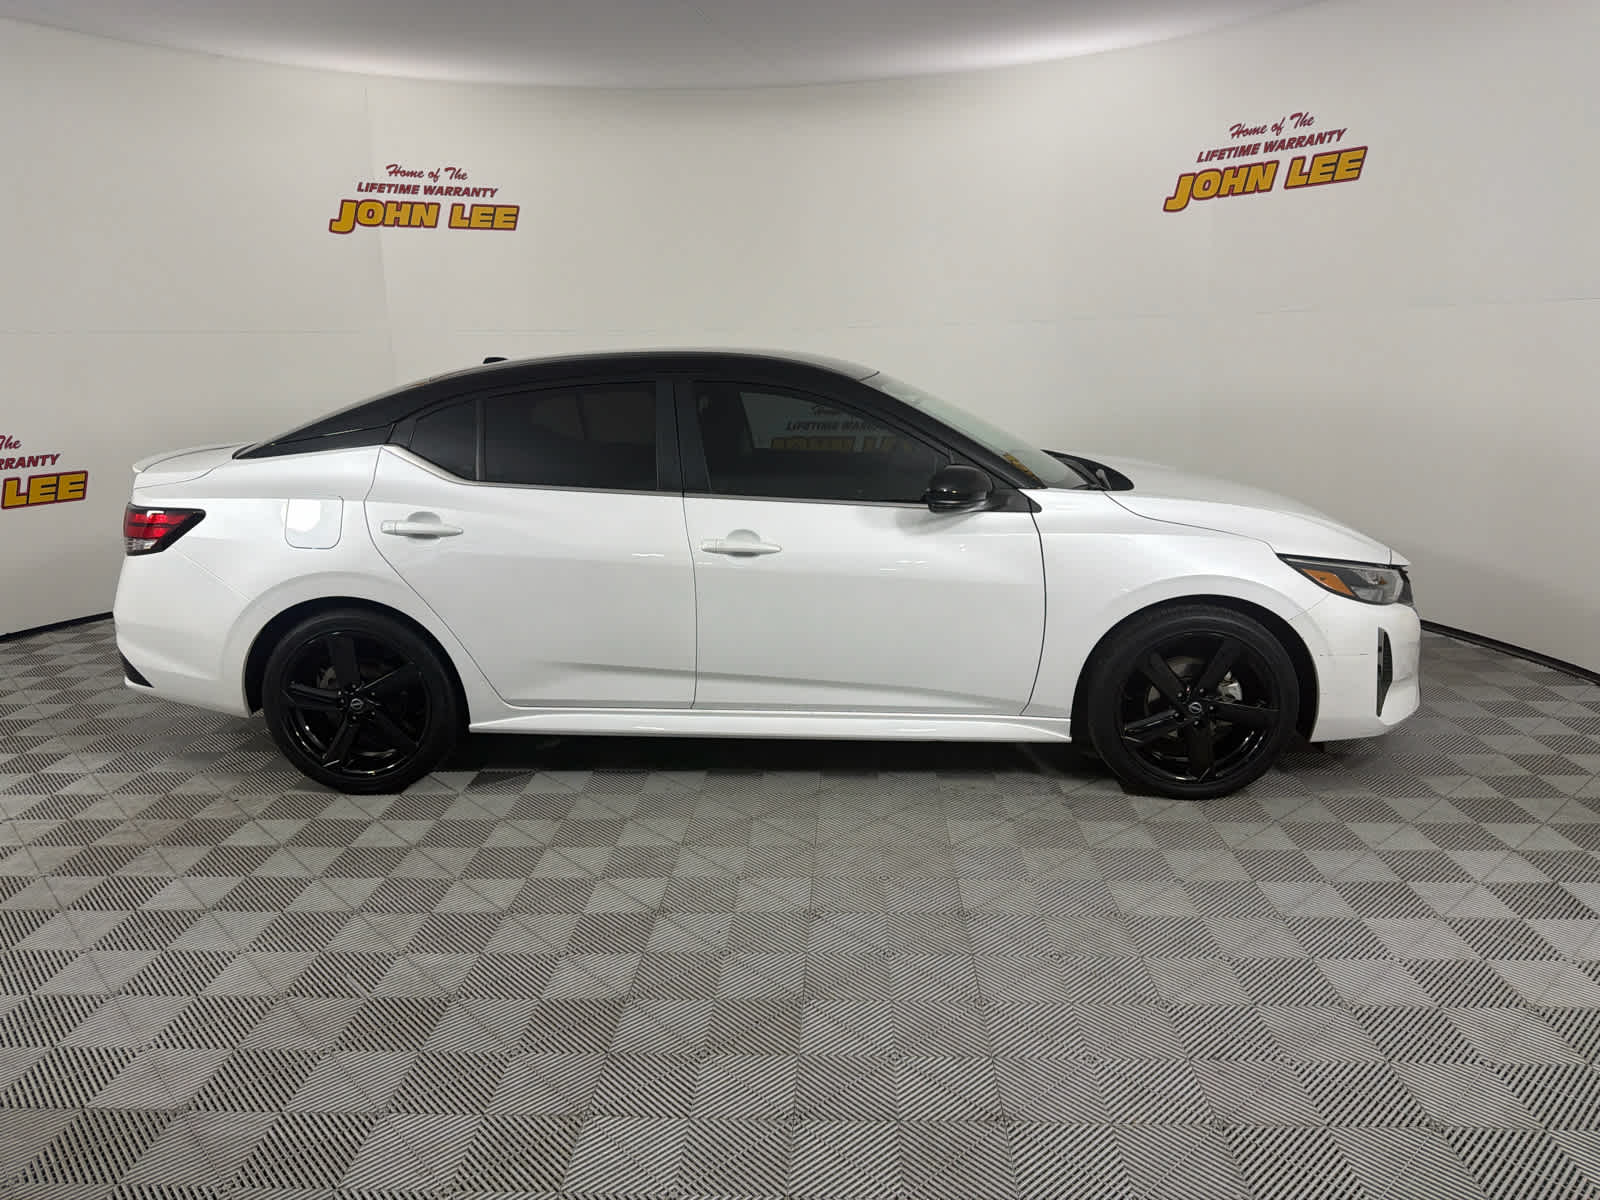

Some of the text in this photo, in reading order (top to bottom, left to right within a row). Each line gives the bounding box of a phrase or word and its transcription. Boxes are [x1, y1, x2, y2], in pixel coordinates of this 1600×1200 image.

[1229, 112, 1315, 139] Home of The
[1197, 128, 1348, 163] LIFETIME WARRANTY
[357, 182, 498, 198] LIFETIME WARRANTY
[386, 164, 468, 182] Home of The
[1163, 146, 1368, 213] JOHN LEE
[329, 199, 520, 234] JOHN LEE
[1, 470, 88, 510] LEE
